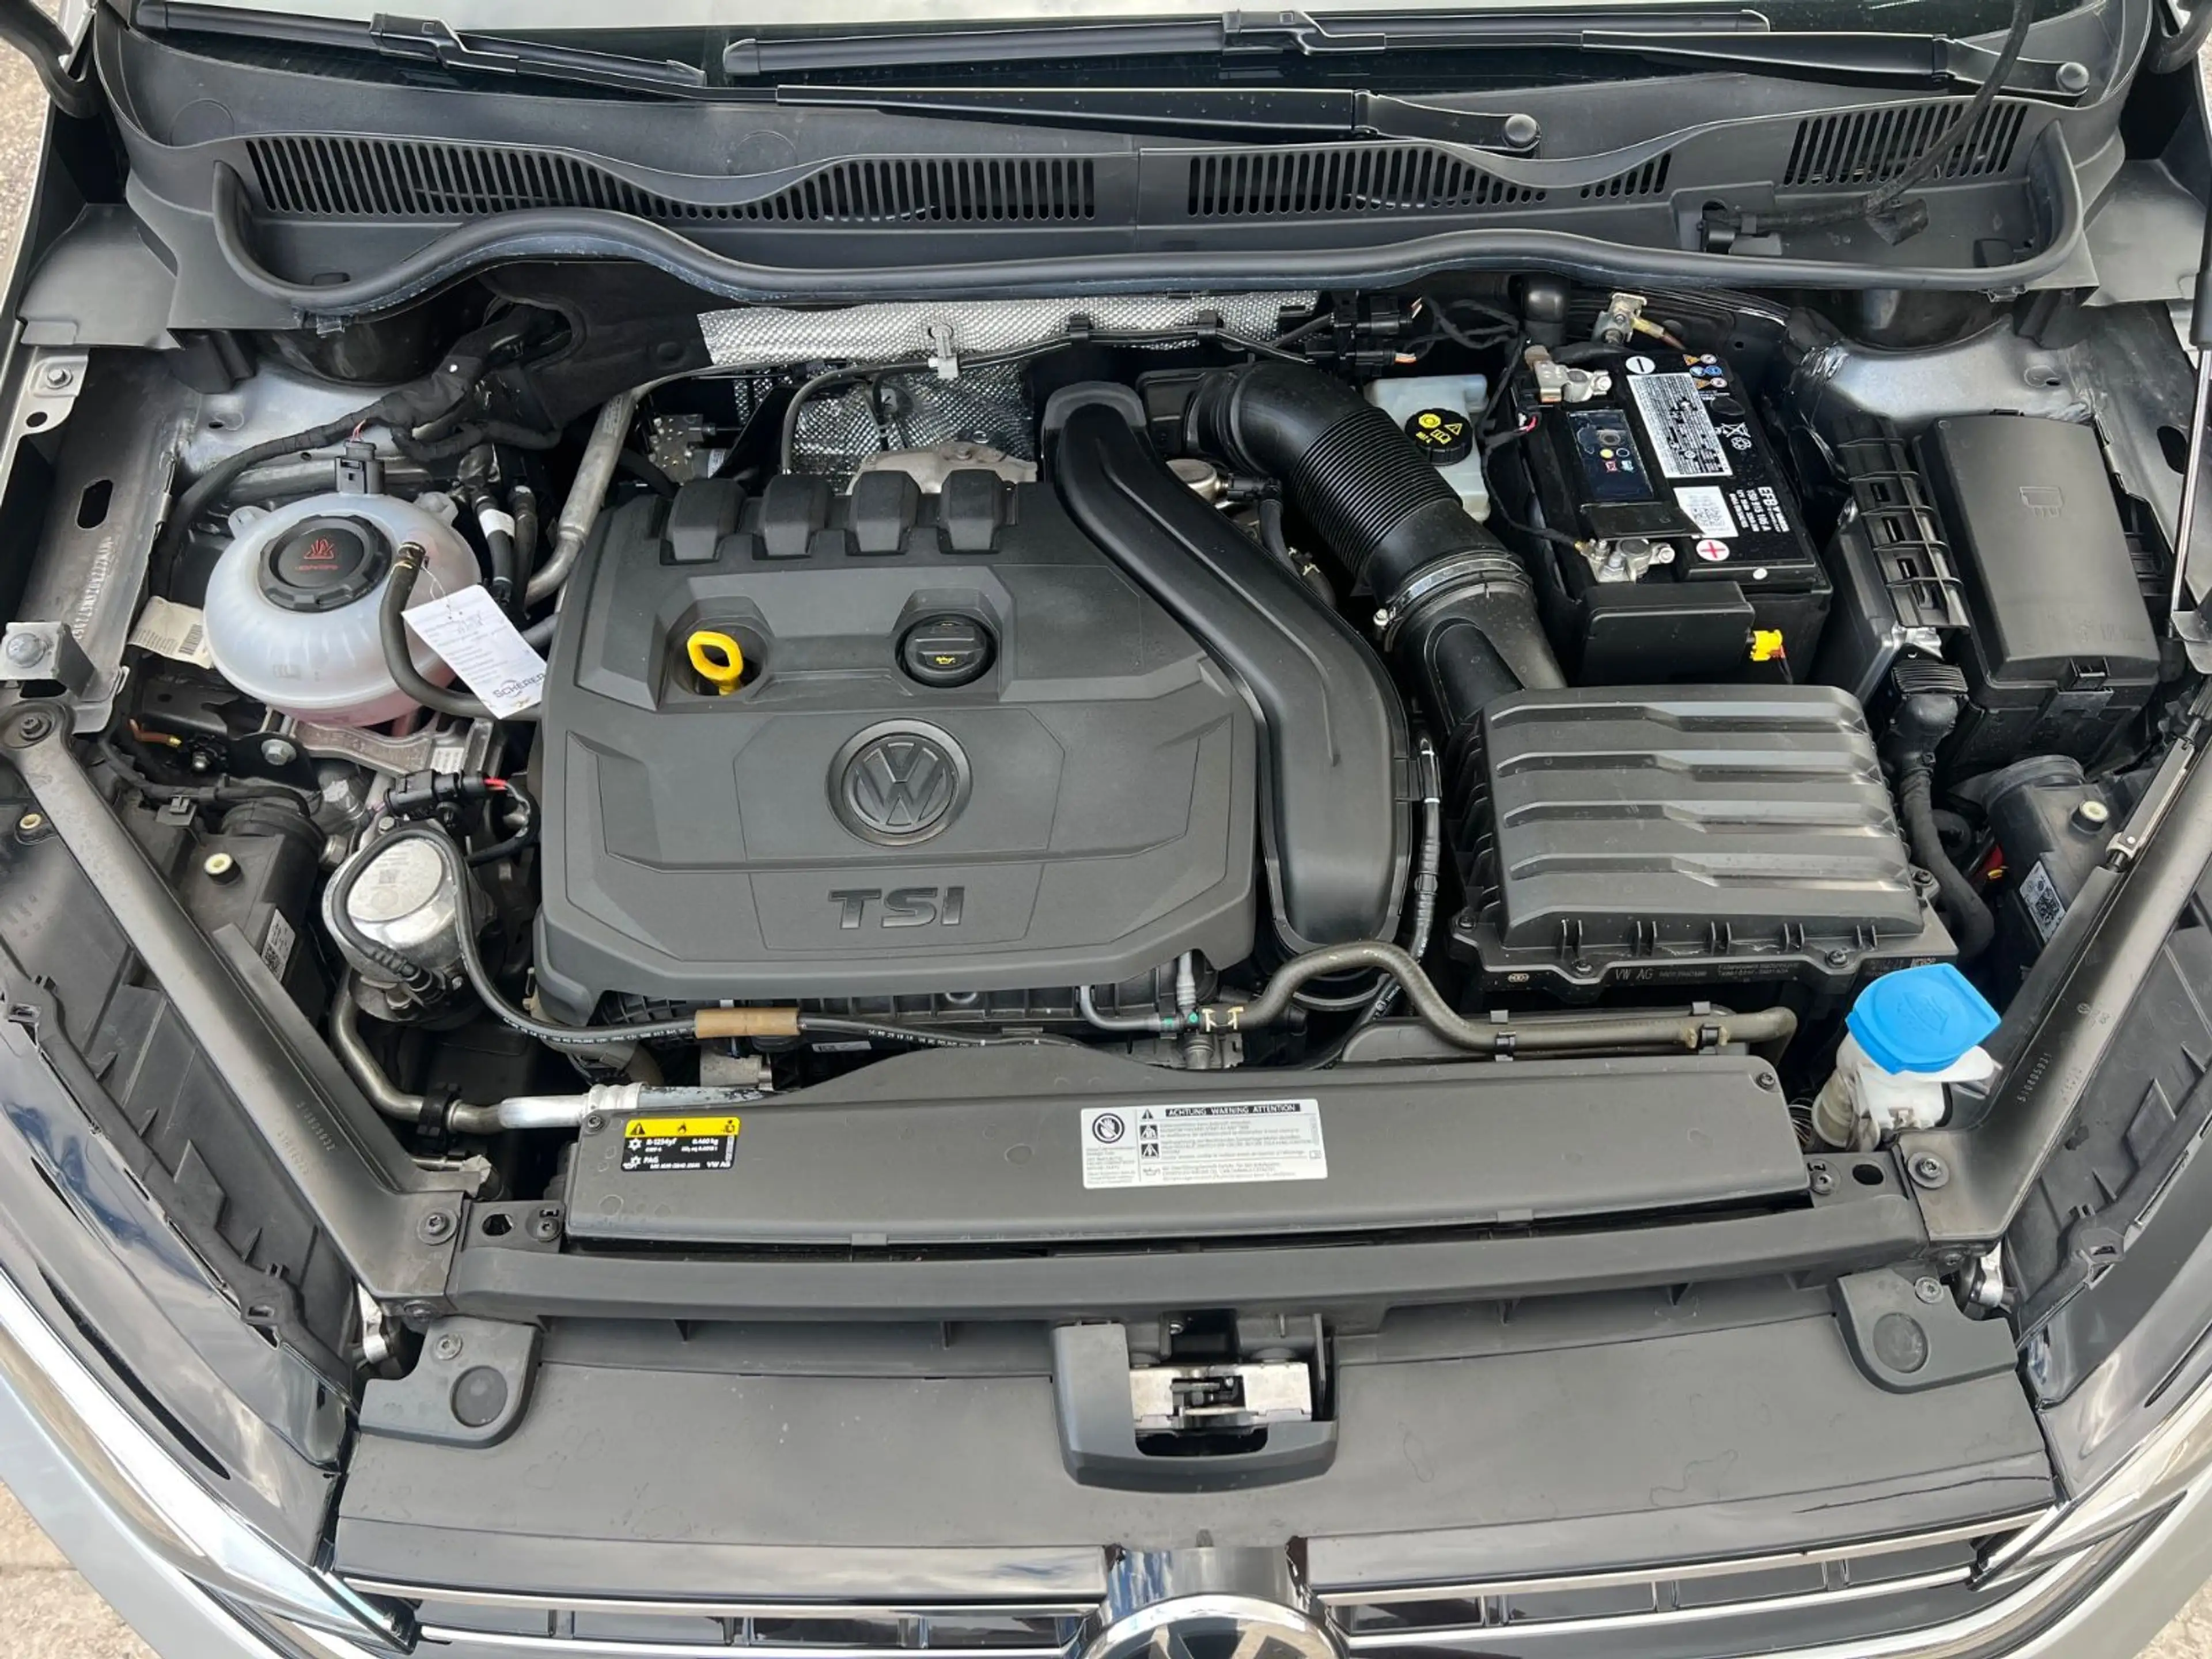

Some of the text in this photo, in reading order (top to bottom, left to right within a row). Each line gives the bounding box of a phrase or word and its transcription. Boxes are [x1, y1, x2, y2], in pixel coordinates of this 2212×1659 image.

[1758, 487, 1778, 505] EFB
[828, 886, 965, 929] TSI
[1615, 968, 1632, 980] VW
[1636, 968, 1654, 980] AG
[1168, 1104, 1296, 1117] ACHTUNG WARNING ATTENTION
